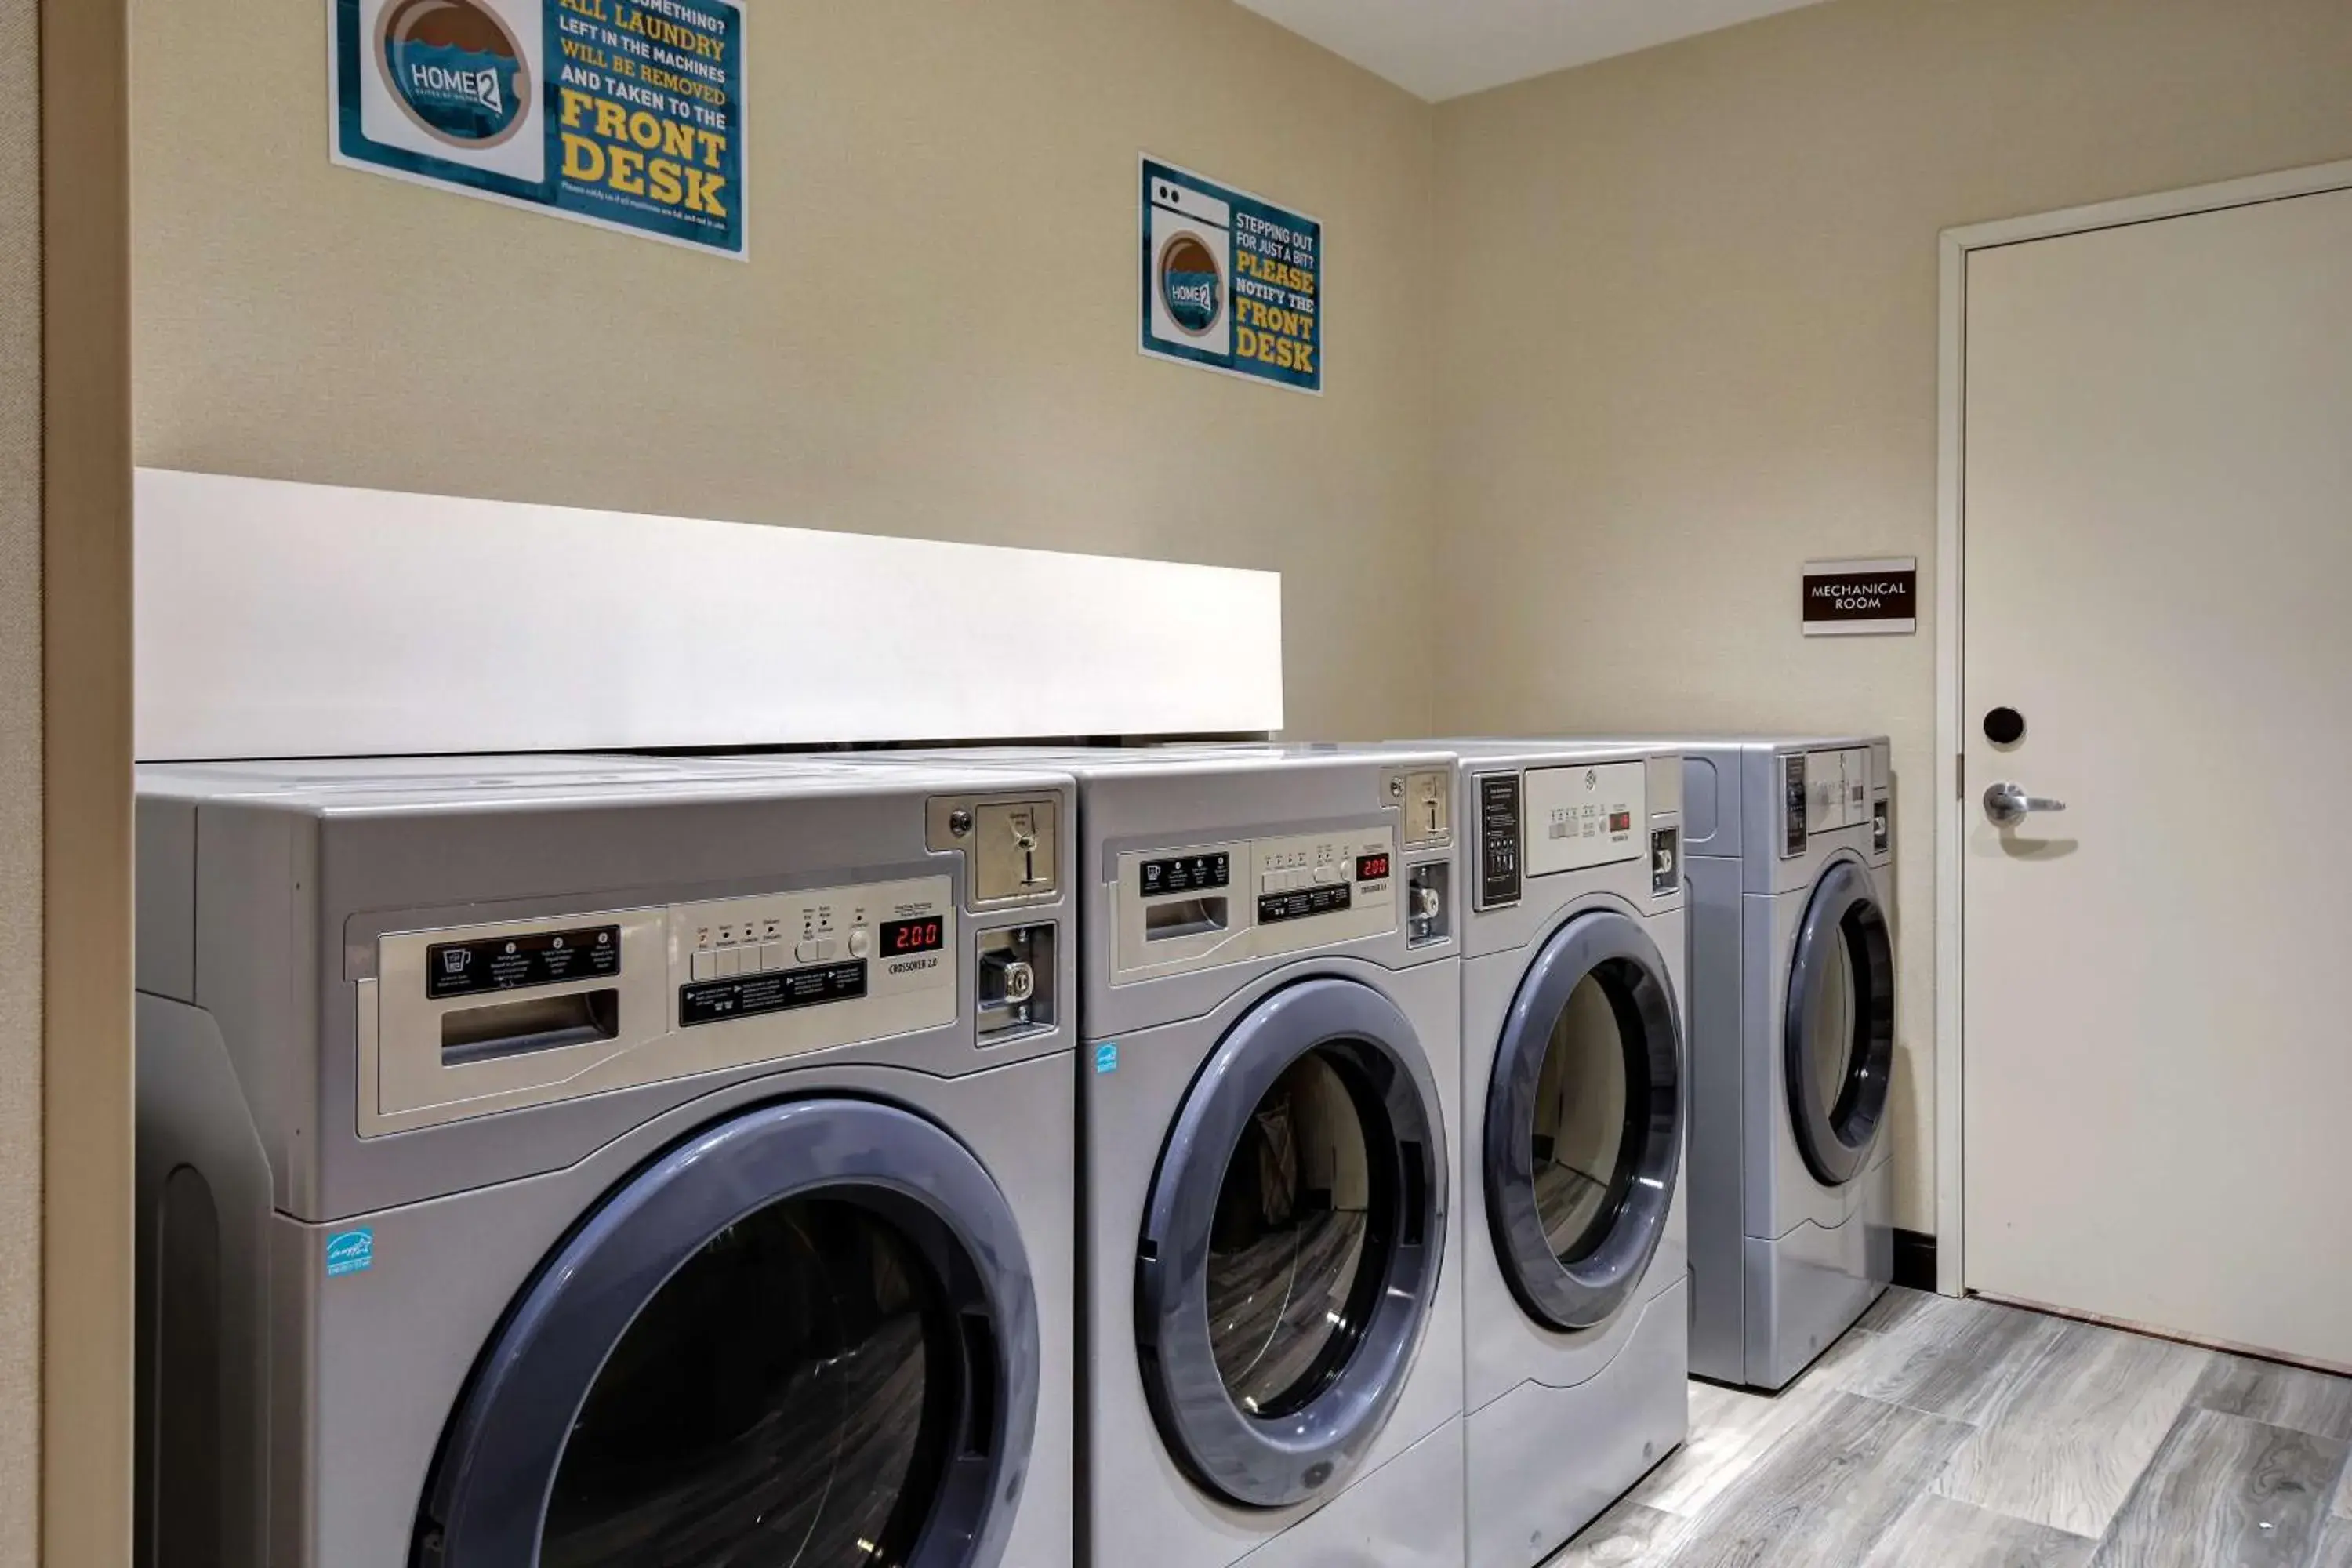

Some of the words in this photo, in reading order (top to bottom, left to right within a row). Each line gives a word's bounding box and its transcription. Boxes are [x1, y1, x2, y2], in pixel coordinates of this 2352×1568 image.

[615, 3, 725, 62] LAUNDRY
[631, 0, 725, 34] METHING?
[559, 13, 598, 40] LEFT
[601, 27, 618, 48] IN
[622, 35, 651, 59] THE
[653, 47, 726, 84] MACHINES
[561, 37, 608, 69] WILL
[612, 54, 635, 77] BE
[640, 64, 726, 106] REMOVED
[560, 64, 602, 91] AND
[605, 75, 664, 111] TAKEN
[668, 97, 691, 118] TO
[693, 105, 726, 131] THE
[560, 87, 726, 169] FRONT
[561, 131, 728, 218] DESK
[1236, 212, 1290, 244] STEPPING
[1292, 231, 1313, 252] OUT
[1236, 230, 1257, 251] FOR
[1258, 238, 1283, 259] JUST
[1283, 247, 1291, 262] A
[1292, 250, 1314, 269] BIT?
[1236, 249, 1315, 294] PLEASE
[1236, 277, 1286, 305] NOTIFY
[1288, 293, 1314, 314] THE
[1236, 296, 1313, 341] FRONT
[1236, 325, 1314, 374] DESK
[1811, 583, 1906, 597] MECHANICAL
[1835, 597, 1881, 610] ROOM
